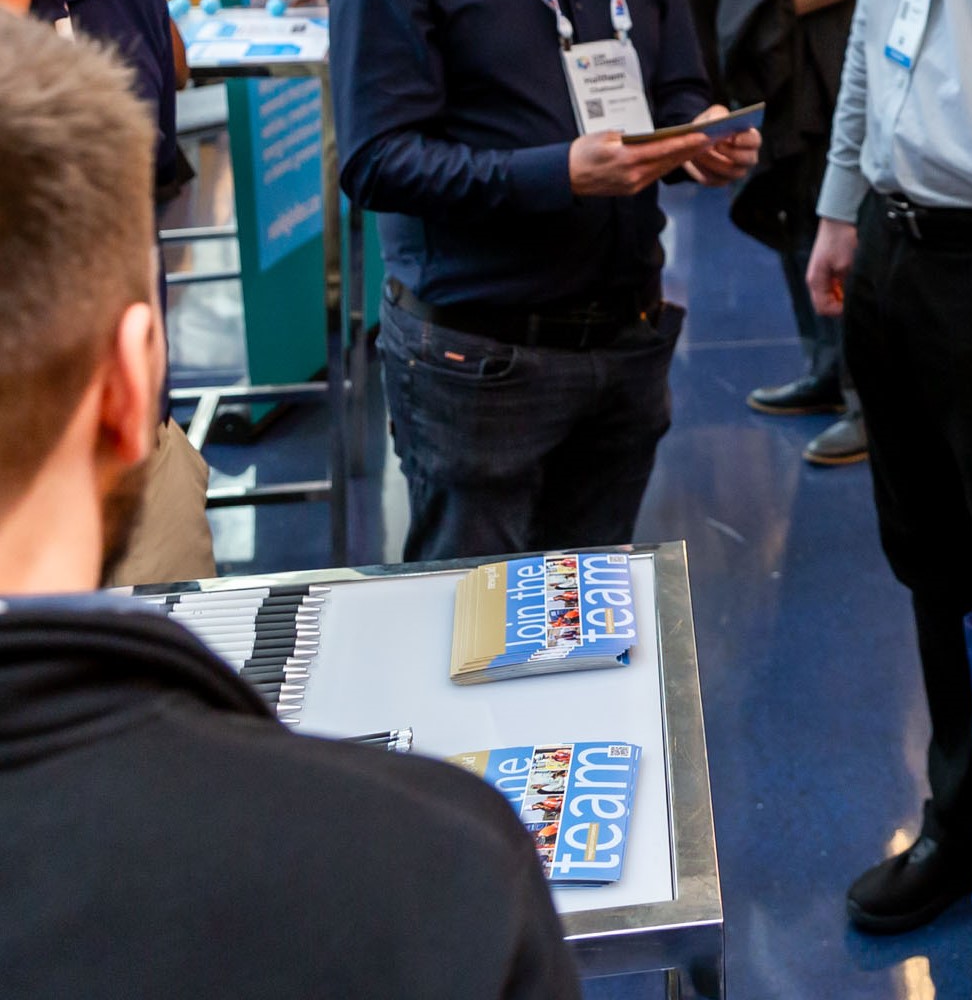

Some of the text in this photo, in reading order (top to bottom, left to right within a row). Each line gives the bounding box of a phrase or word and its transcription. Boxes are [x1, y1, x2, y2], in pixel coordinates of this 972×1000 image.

[507, 565, 545, 600] the
[582, 555, 636, 643] team
[548, 747, 632, 873] team
